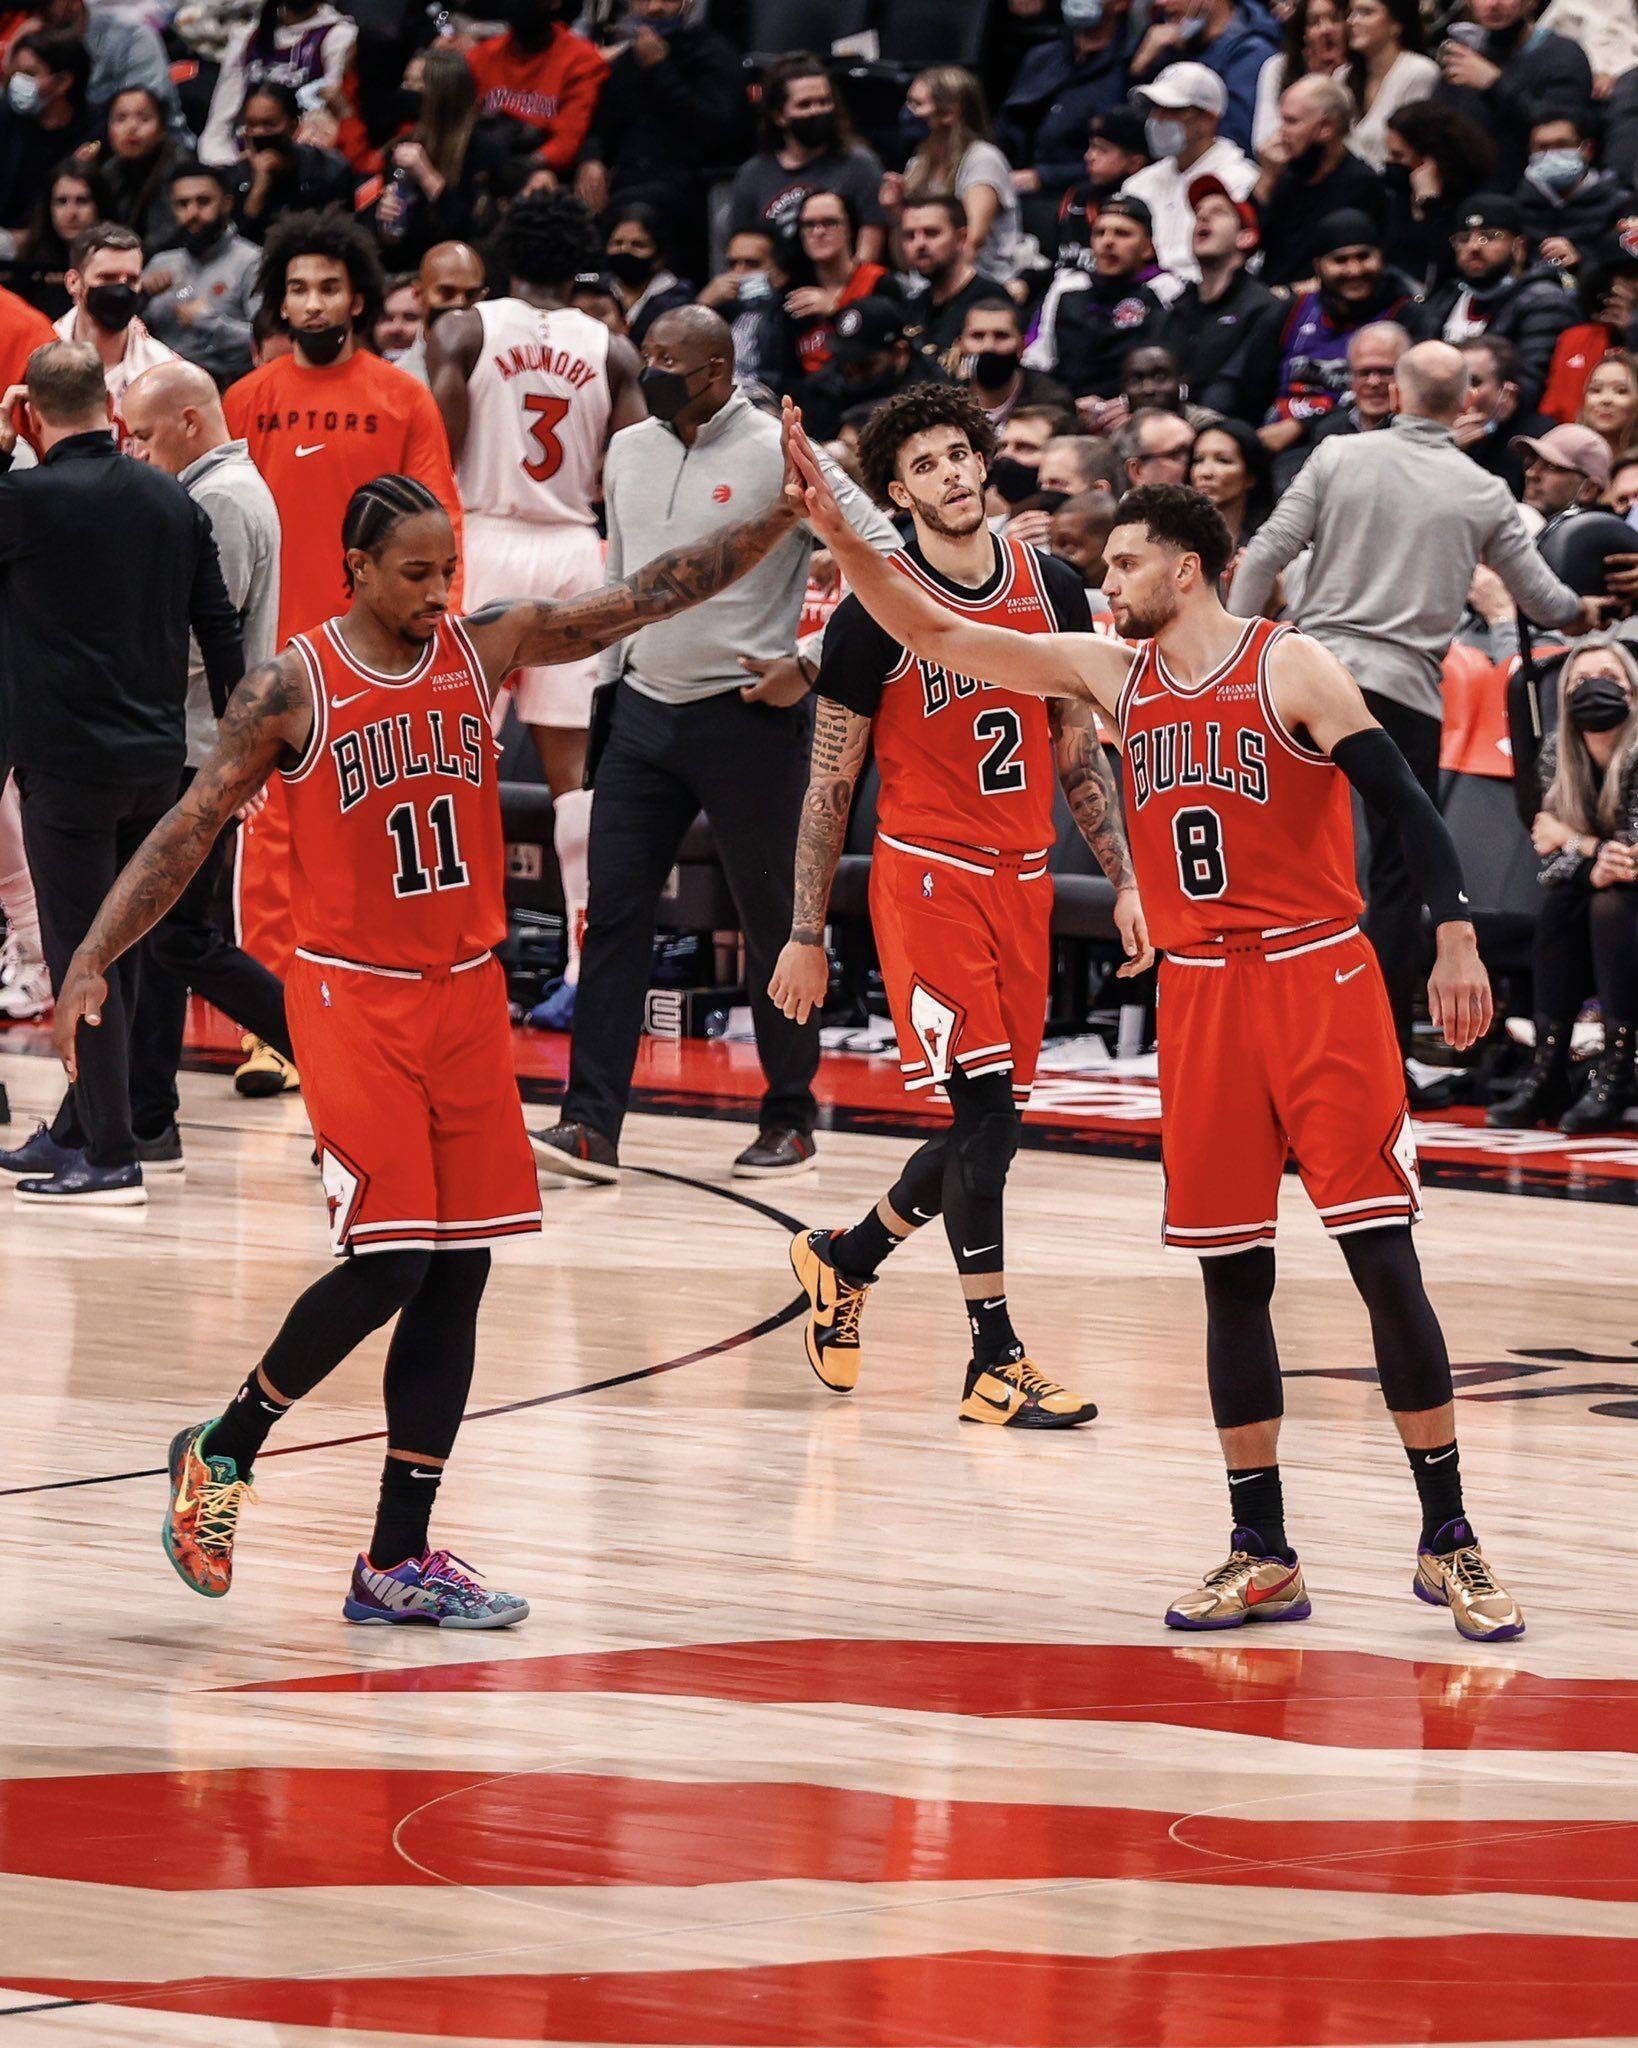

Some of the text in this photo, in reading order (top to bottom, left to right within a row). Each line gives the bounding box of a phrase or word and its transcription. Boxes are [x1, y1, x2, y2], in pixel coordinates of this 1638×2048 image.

[522, 393, 570, 482] 3
[1215, 693, 1256, 701] EYEWEAR
[330, 710, 482, 814] BULLS
[973, 707, 1027, 796] 2
[1127, 721, 1269, 812] BULLS
[386, 794, 470, 899] 11
[1171, 805, 1228, 900] 8
